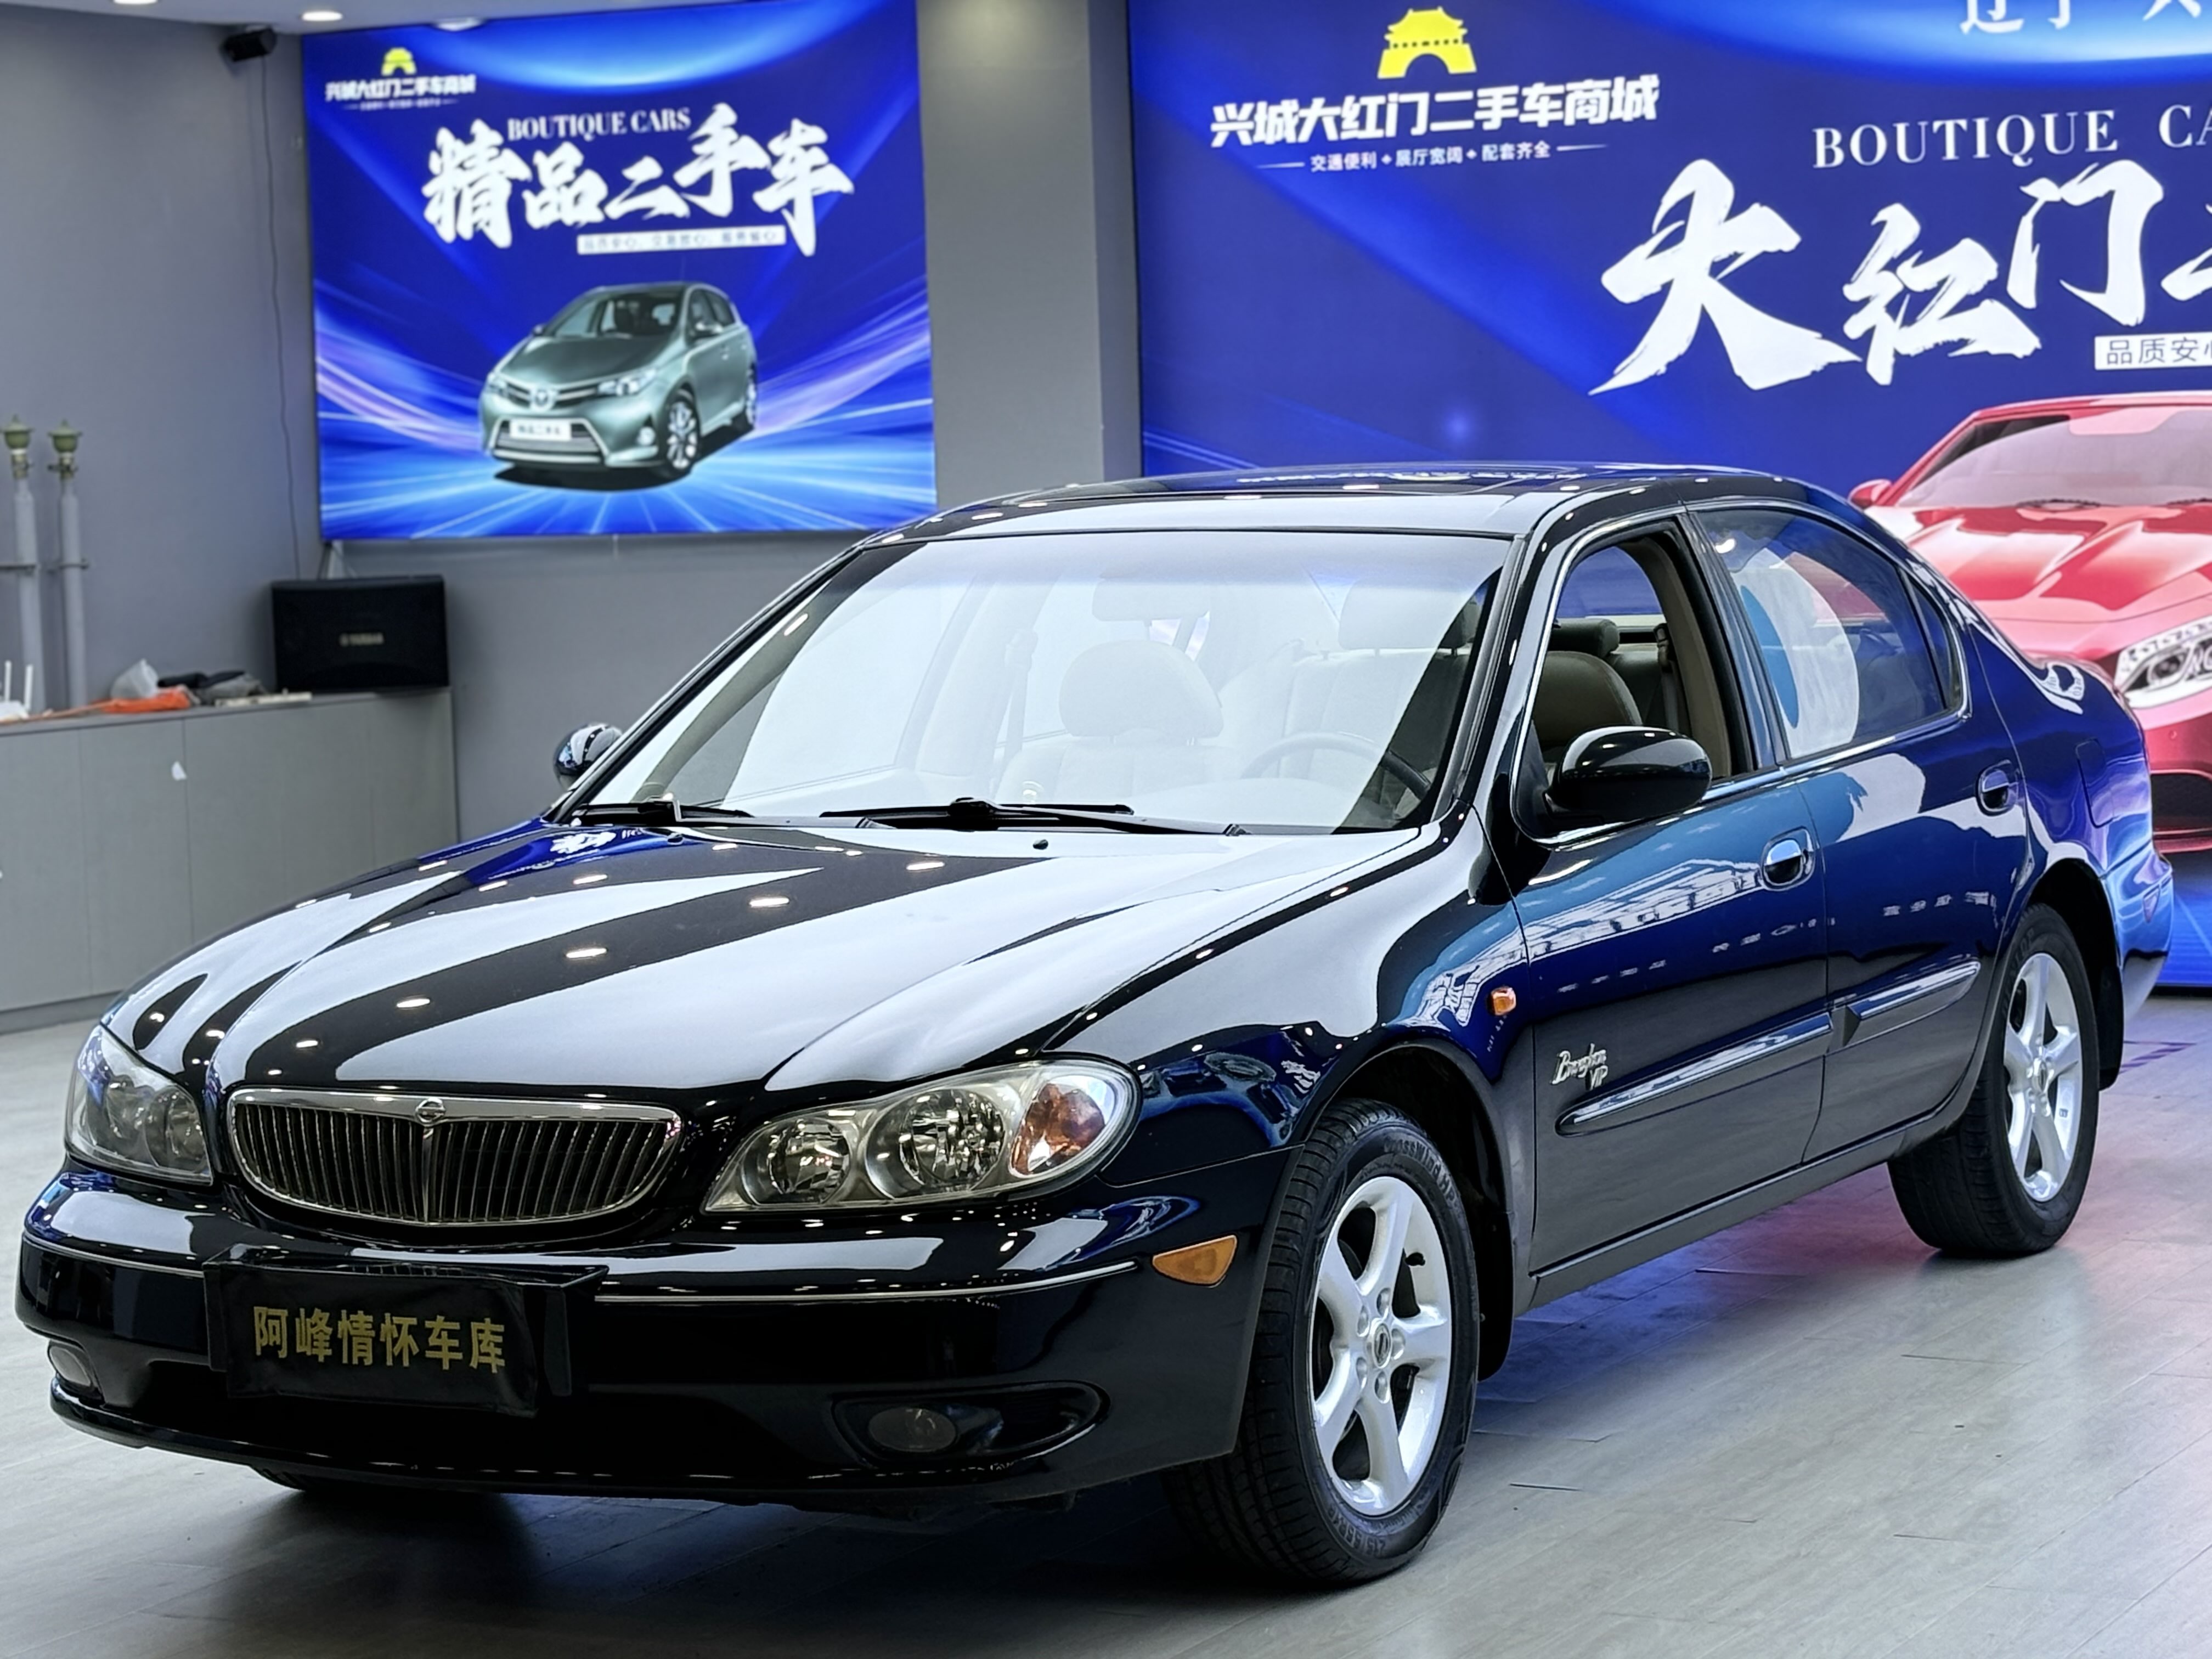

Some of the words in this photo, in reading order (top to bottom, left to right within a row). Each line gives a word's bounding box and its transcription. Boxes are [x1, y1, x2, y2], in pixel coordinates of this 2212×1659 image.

[507, 112, 628, 141] BOUTIQUE
[630, 108, 691, 133] CARS
[1210, 74, 1659, 148] 兴城大红门二手车商城
[1813, 110, 2118, 167] BOUTIQUE
[421, 103, 854, 257] 精品二手车
[1311, 151, 1377, 172] 交通便利
[1395, 146, 1463, 167] 展厅宽阔
[1482, 140, 1551, 162] 配套齐全
[1589, 159, 2212, 394] 大红门
[253, 1306, 506, 1374] 阿峰情怀车库
